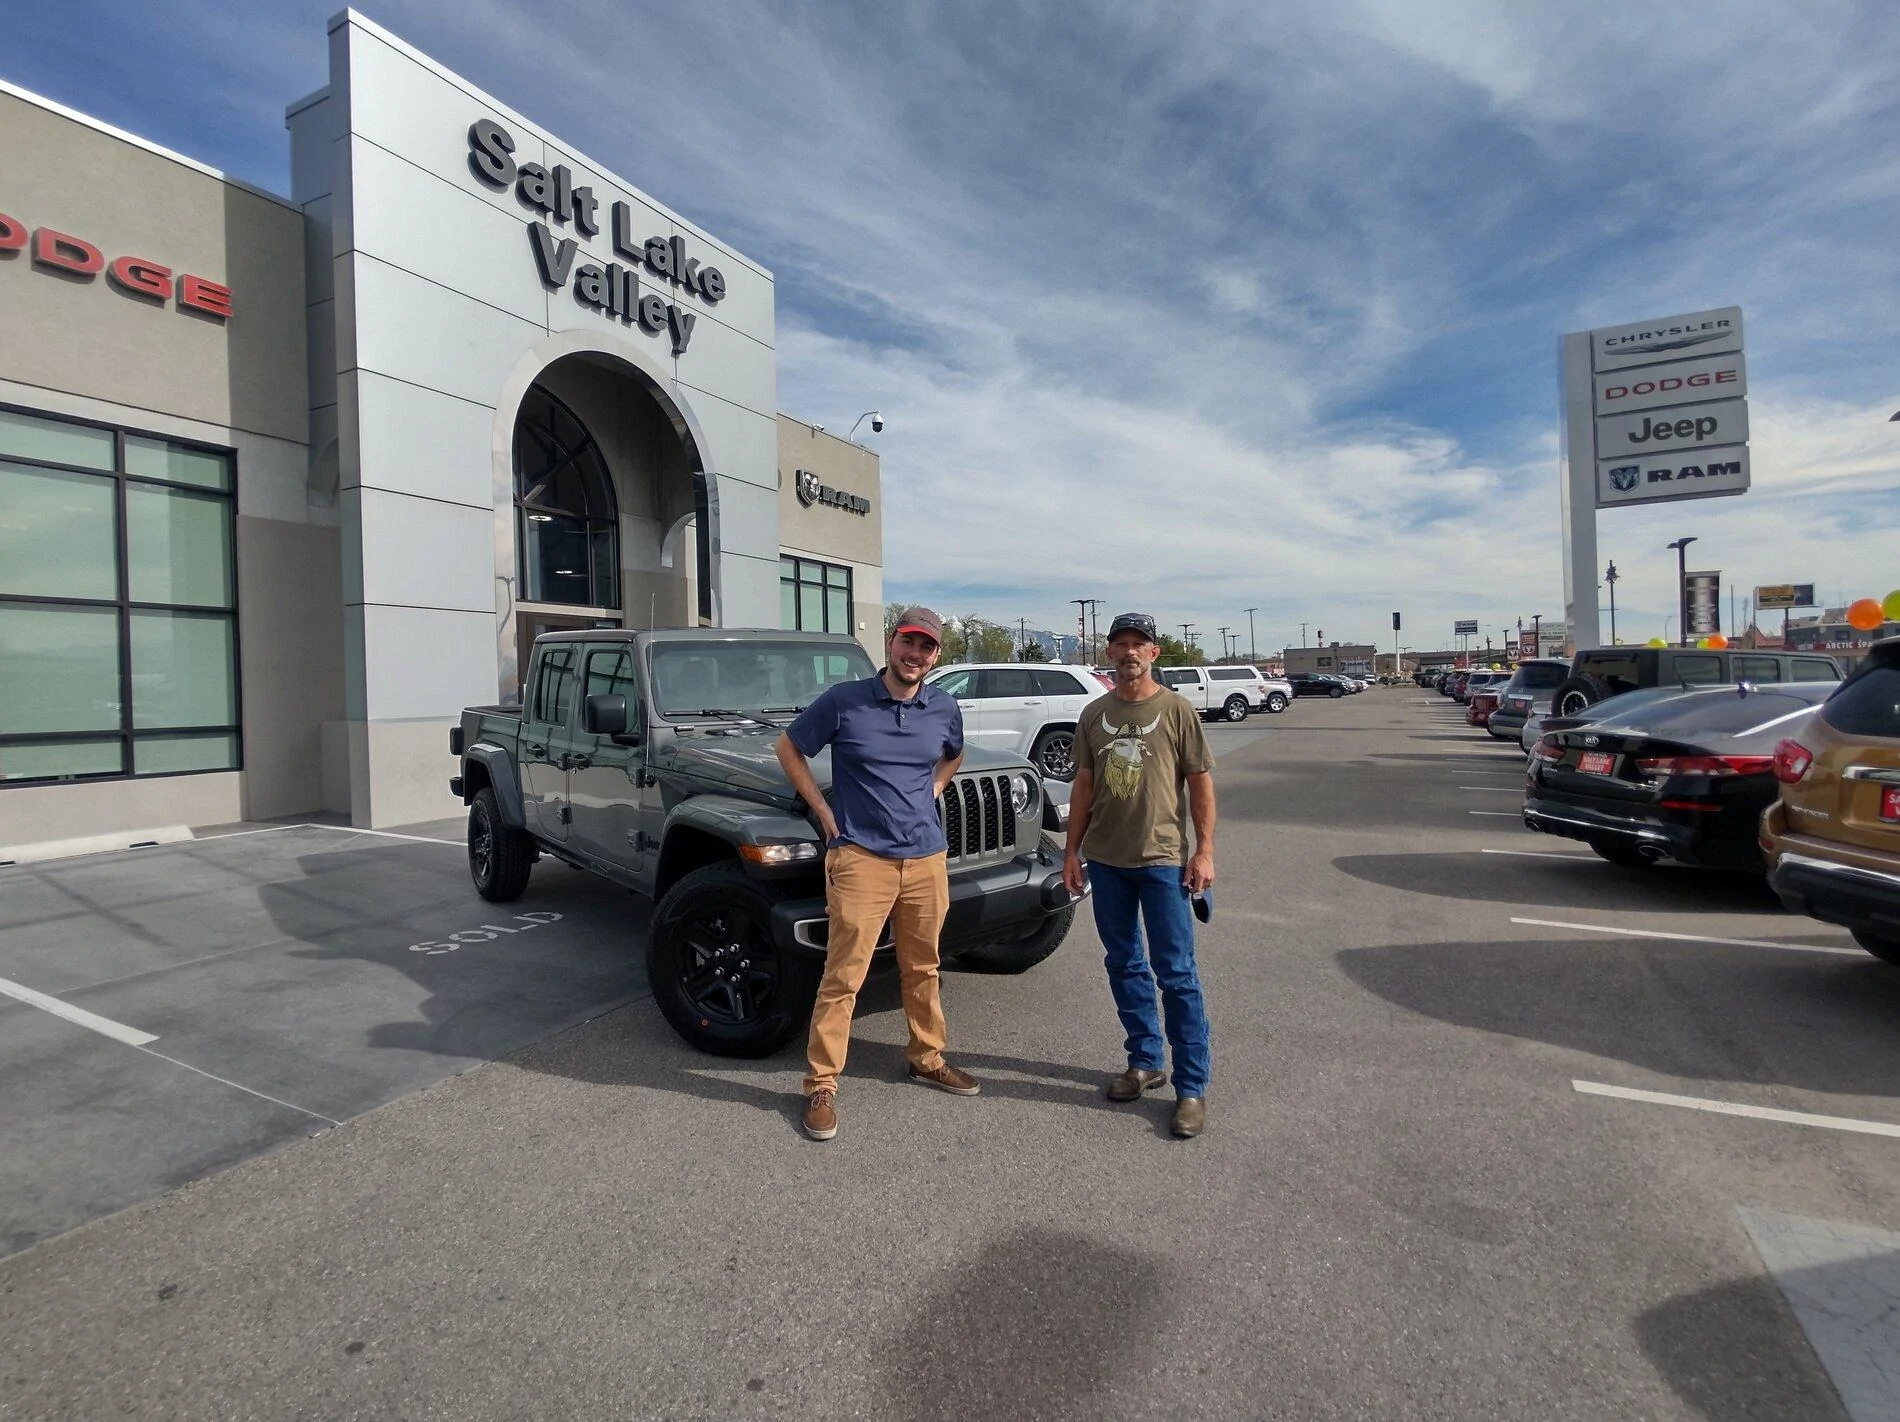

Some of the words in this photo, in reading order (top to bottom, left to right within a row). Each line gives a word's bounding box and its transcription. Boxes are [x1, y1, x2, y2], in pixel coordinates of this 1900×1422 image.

[467, 119, 599, 240] Salt
[612, 201, 726, 305] Lake
[527, 221, 696, 356] Valley
[1605, 319, 1732, 346] CHRYSLER
[1605, 369, 1737, 400] DODGE
[1628, 416, 1718, 443] Jeep
[1647, 461, 1741, 483] RAM
[819, 485, 871, 515] RAM
[1585, 763, 1605, 771] VALLEY
[409, 912, 564, 955] SOLD
